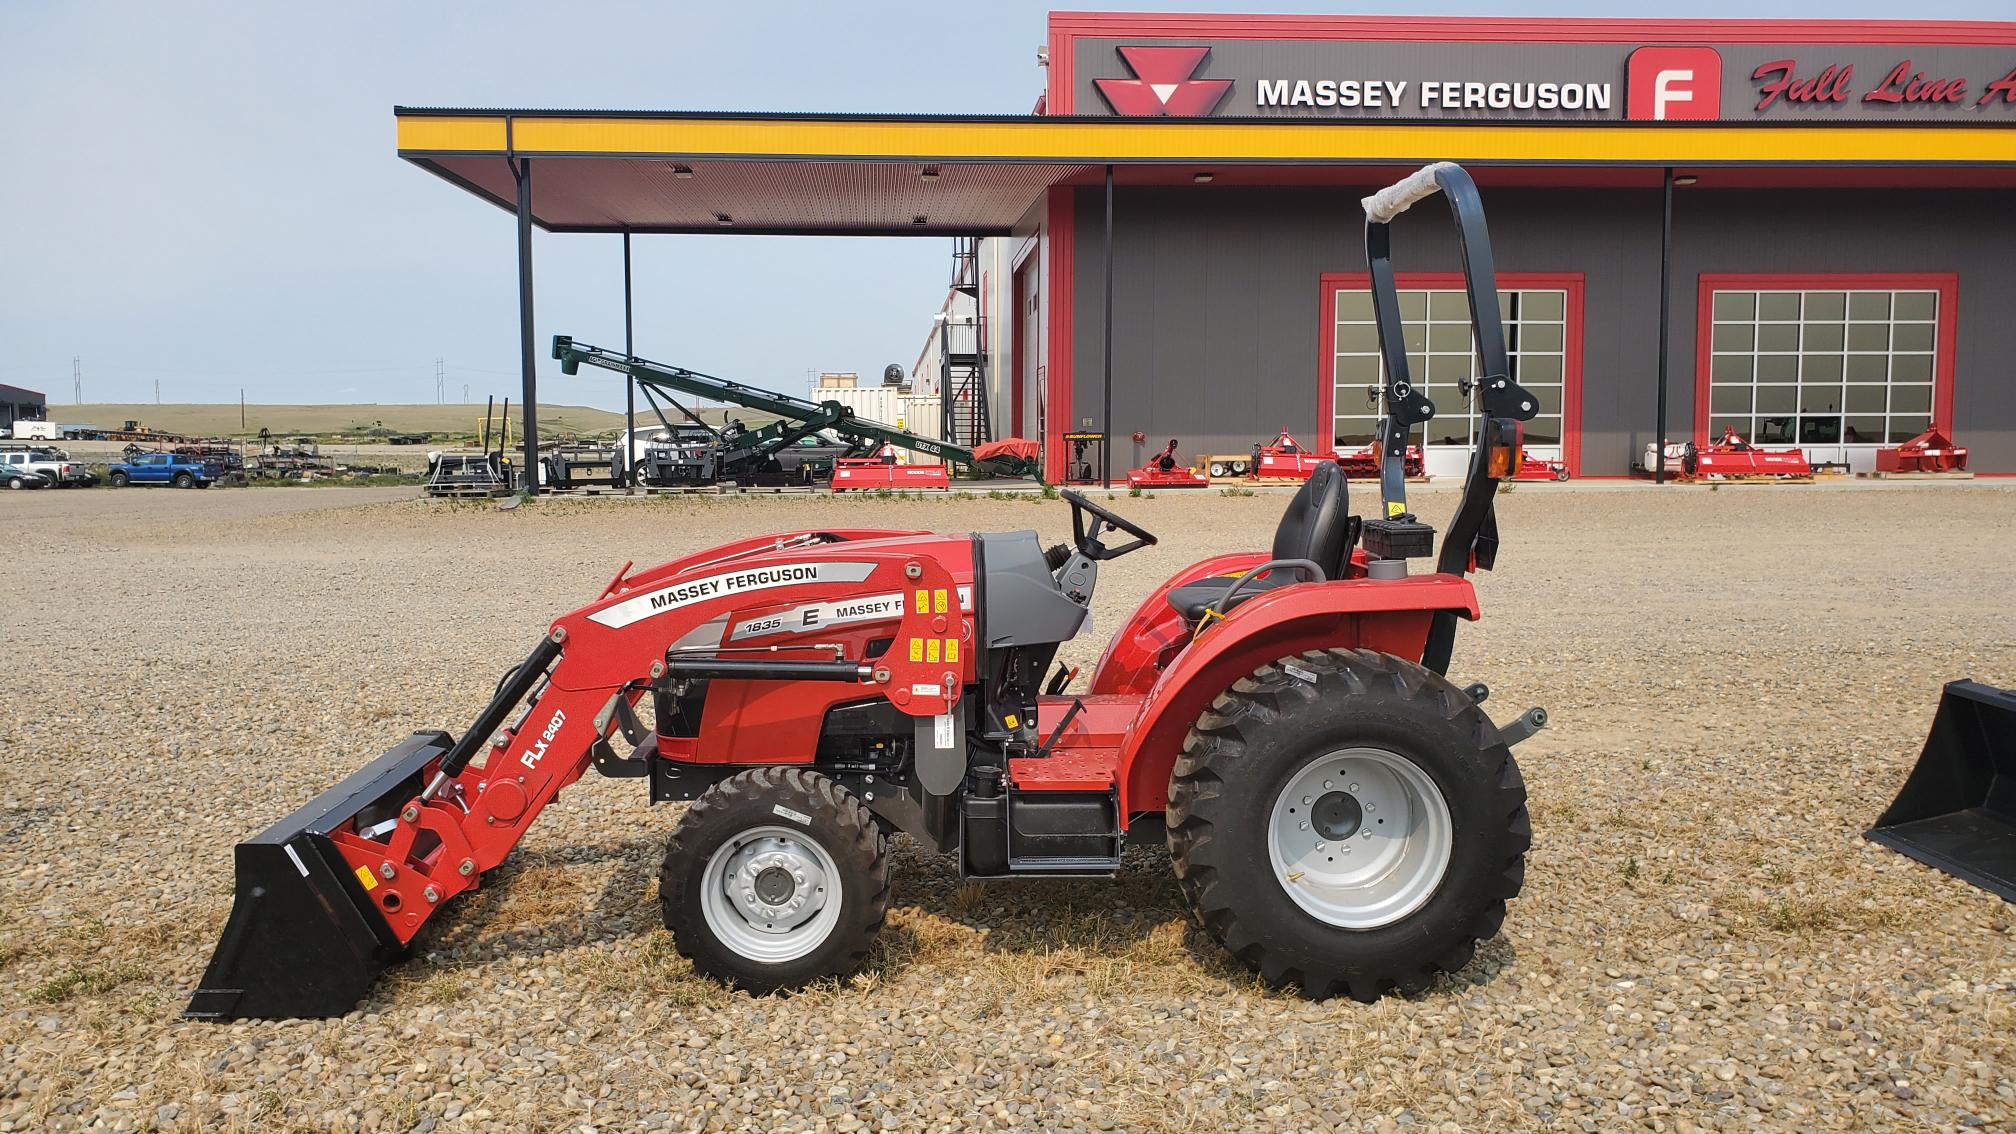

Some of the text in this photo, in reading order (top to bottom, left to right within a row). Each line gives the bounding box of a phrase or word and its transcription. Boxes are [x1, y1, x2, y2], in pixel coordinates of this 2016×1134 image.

[1257, 79, 1611, 109] MASSEY FERGUSON
[1654, 69, 1694, 120] F
[1751, 58, 1855, 111] Full
[1861, 59, 1968, 104] Line
[915, 440, 941, 454] UTX 44
[650, 567, 817, 609] MASSEY FERGUSON
[745, 618, 781, 633] 1835
[802, 608, 820, 626] E
[836, 601, 891, 618] MASSEY
[520, 709, 566, 770] FLX 2407
